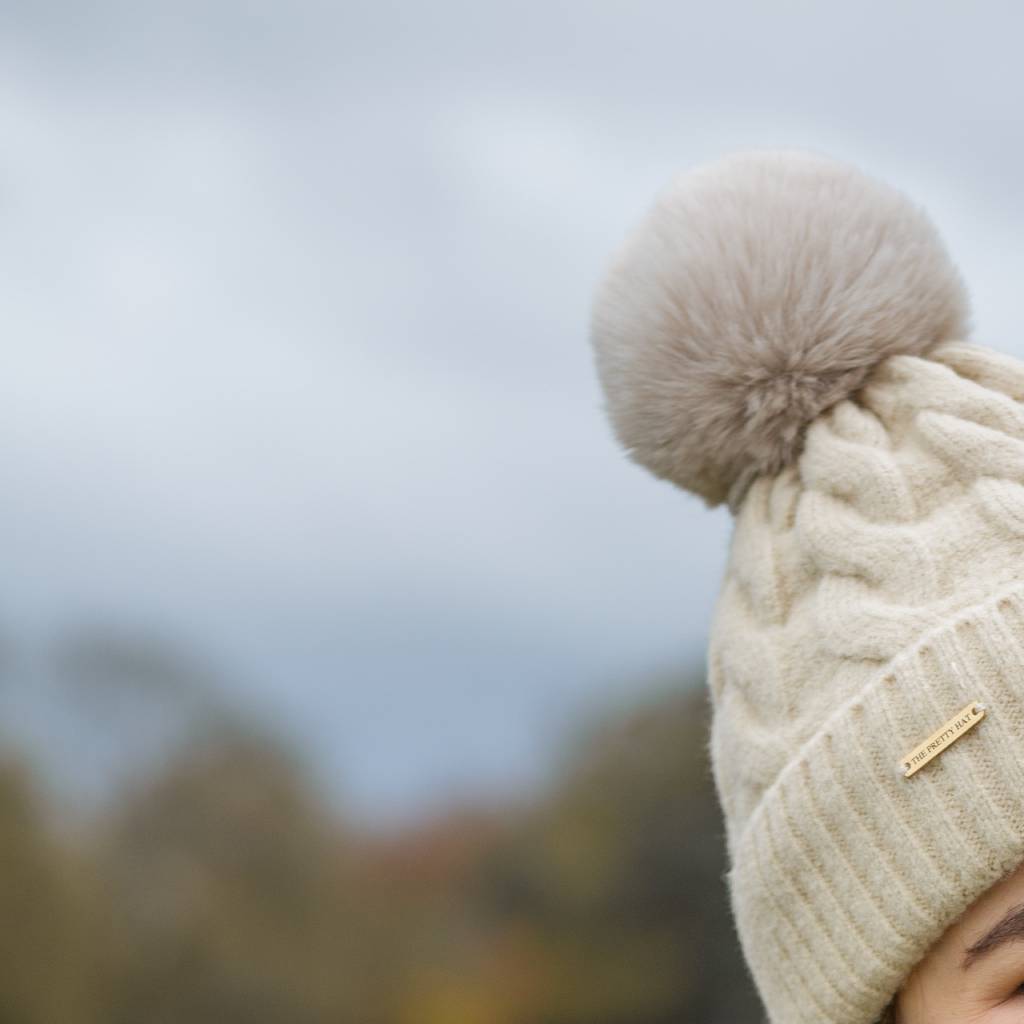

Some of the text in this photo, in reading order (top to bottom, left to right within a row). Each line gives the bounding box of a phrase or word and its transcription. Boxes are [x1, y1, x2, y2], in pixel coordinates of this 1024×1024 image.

[910, 713, 972, 765] THE PRETTY HAT
